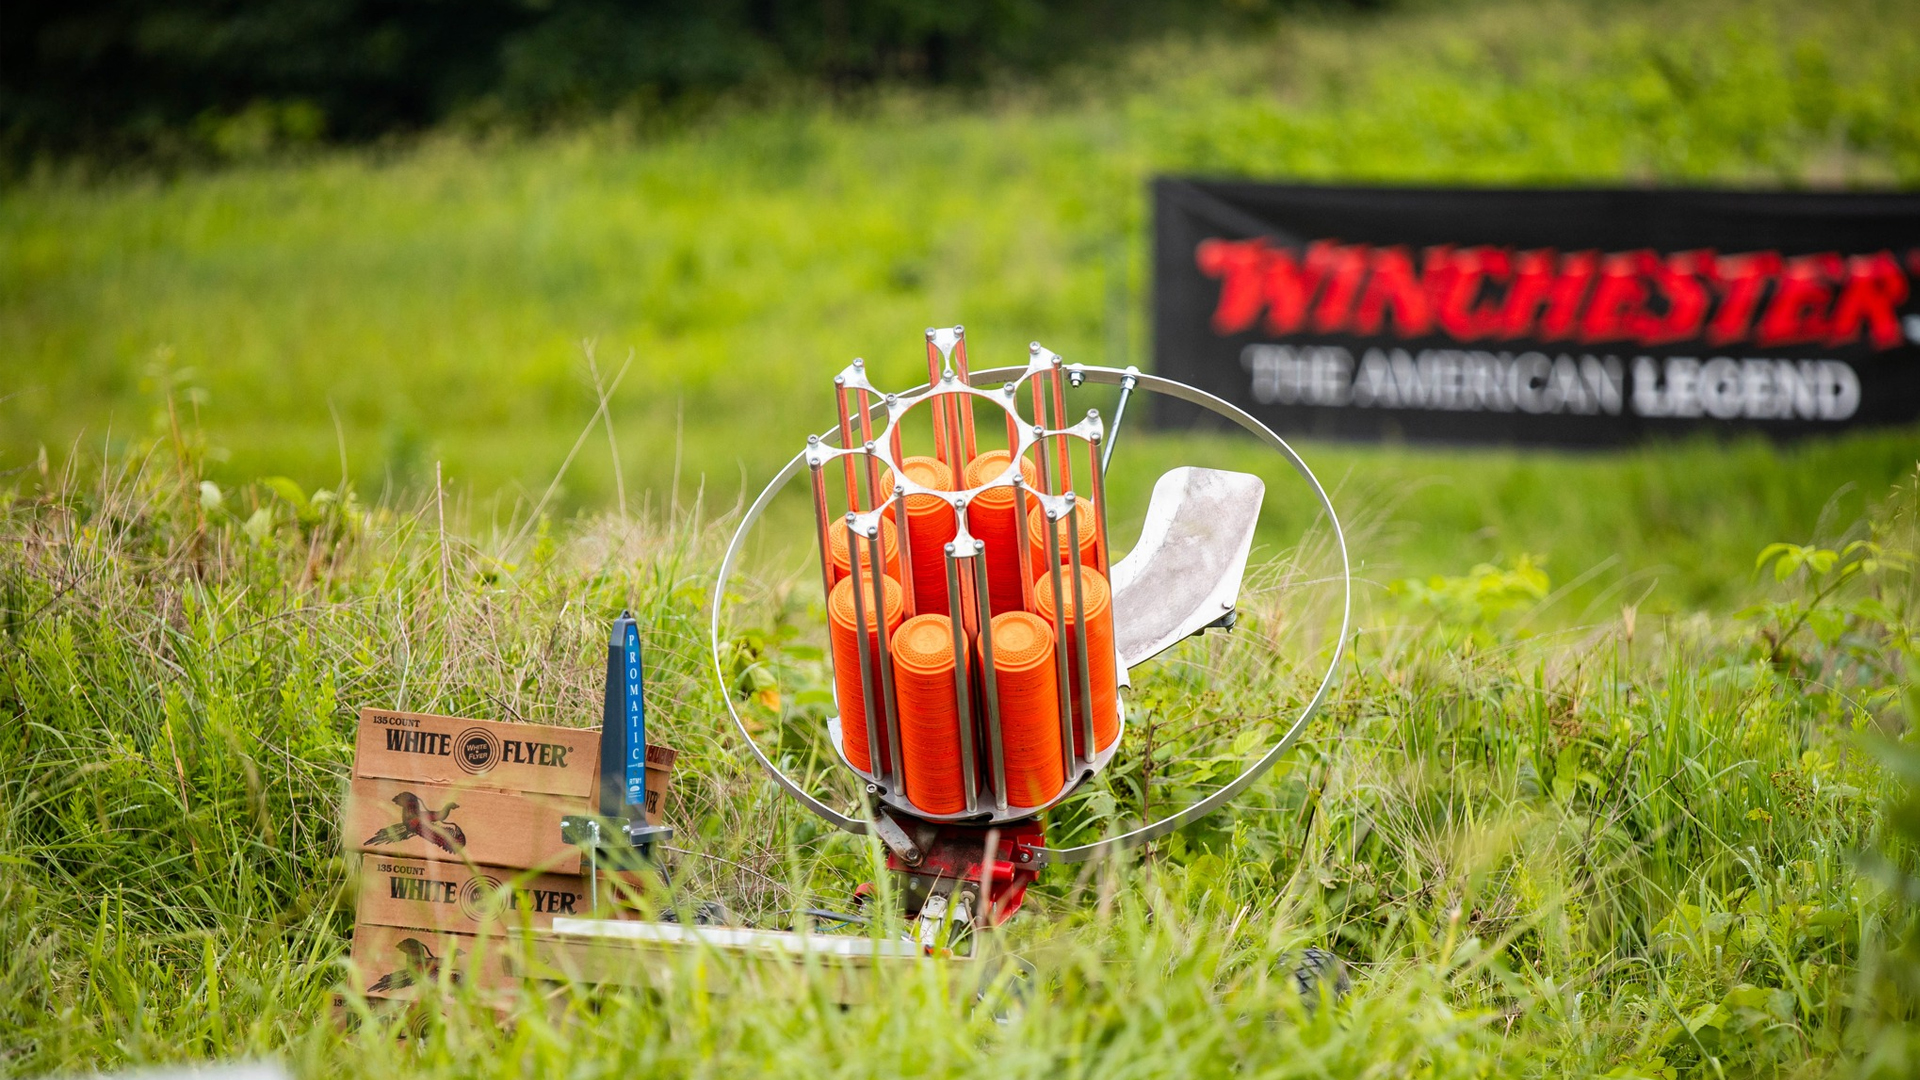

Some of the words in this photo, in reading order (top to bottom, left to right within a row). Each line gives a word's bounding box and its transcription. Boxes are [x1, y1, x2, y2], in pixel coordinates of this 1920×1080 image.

[1198, 237, 1907, 348] WINCHESTER
[1241, 345, 1354, 406] THE
[1351, 348, 1624, 415] AMERICAN
[1632, 354, 1862, 420] LEGEND
[628, 634, 640, 760] PROMATIC
[373, 715, 388, 725] 135
[389, 717, 420, 728] COUNT
[386, 728, 452, 757] WHITE
[466, 743, 488, 752] WHITE
[468, 752, 488, 760] FLYER
[377, 863, 392, 873] 135
[393, 865, 425, 876] COUNT
[390, 876, 457, 904] WHITE
